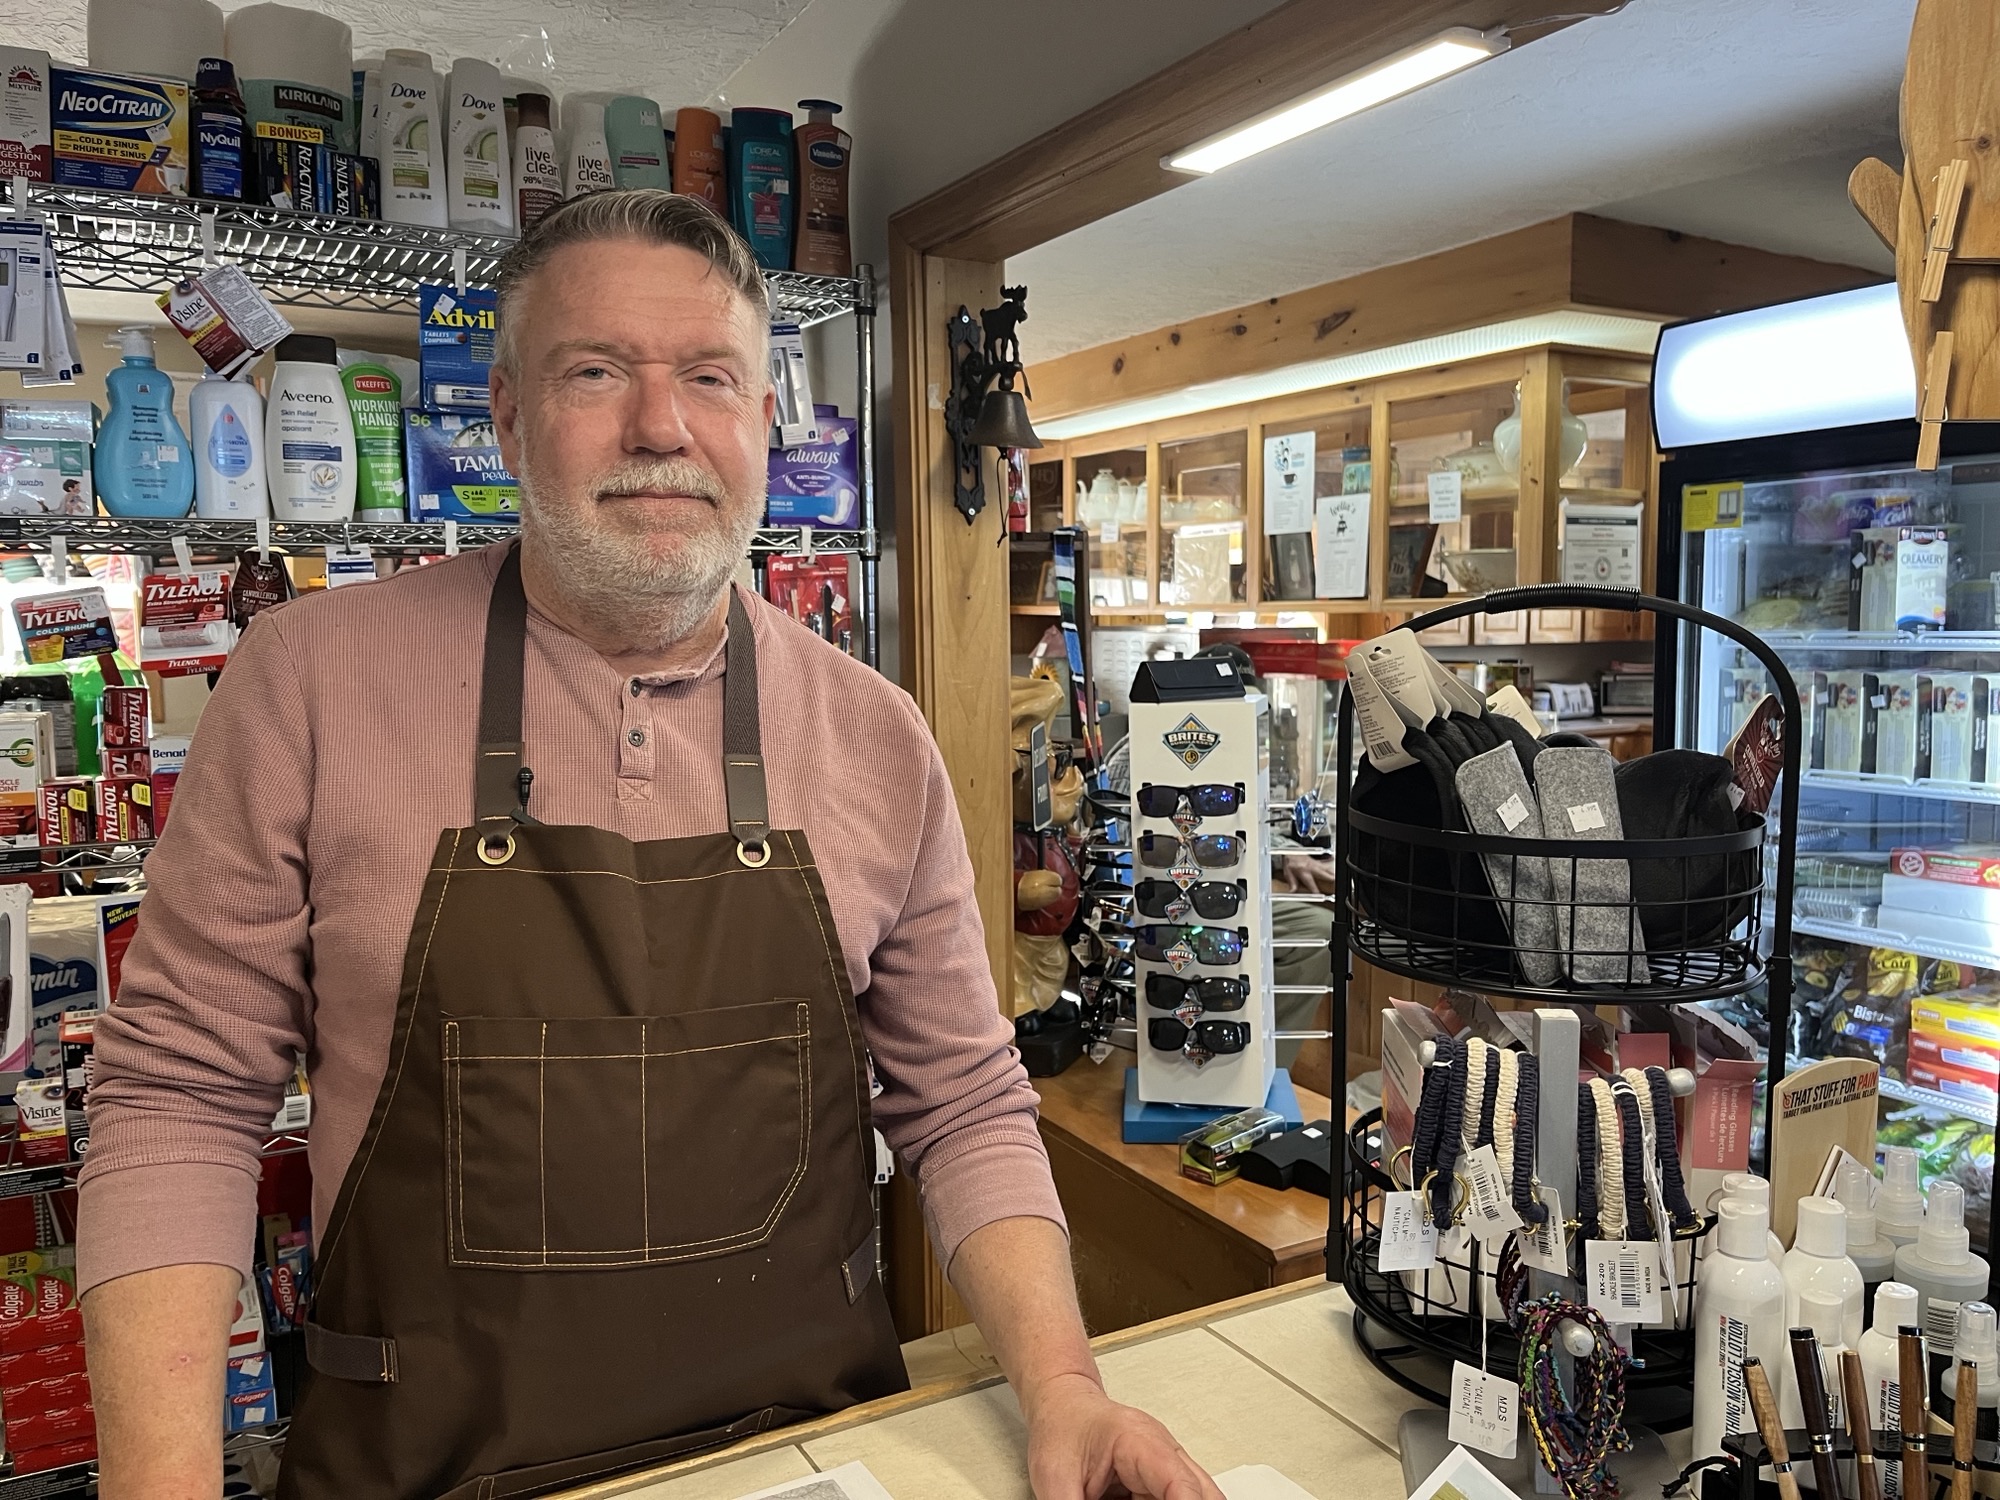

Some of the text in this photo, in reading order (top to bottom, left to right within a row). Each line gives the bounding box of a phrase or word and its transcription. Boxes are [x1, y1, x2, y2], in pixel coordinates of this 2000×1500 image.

[8, 83, 42, 92] MIXTURE
[391, 82, 427, 100] Dove
[278, 88, 341, 112] KIRKLAND
[462, 93, 496, 112] Dove
[200, 131, 240, 149] NyQuil
[269, 126, 309, 140] BONUS
[0, 143, 23, 153] UGH
[78, 135, 103, 145] COLD
[104, 137, 112, 146] &
[113, 140, 140, 150] SINUS
[0, 151, 41, 161] GESTION
[72, 143, 105, 155] RHUME
[107, 147, 119, 156] ET
[120, 150, 147, 160] SINUS
[525, 147, 551, 164] live
[811, 147, 843, 161] Vaseline
[19, 162, 30, 170] ET
[526, 160, 560, 178] clean
[577, 155, 603, 171] live
[298, 144, 313, 213] REACTINE
[336, 153, 350, 216] REACTINE
[523, 176, 542, 185] 98%
[578, 169, 612, 185] clean
[809, 173, 837, 186] Cocoa
[525, 191, 554, 199] COCONUT
[809, 183, 840, 195] Radiant
[171, 297, 206, 324] Visine
[424, 308, 496, 330] Advil
[356, 380, 391, 389] O'KEEFFE'S
[280, 389, 333, 404] Aveeno
[297, 410, 318, 418] Relief
[350, 399, 401, 413] WORKING
[359, 413, 400, 427] HANDS
[410, 414, 431, 427] 96
[449, 454, 504, 473] TAM
[786, 448, 841, 470] always
[462, 490, 470, 500] S
[1901, 553, 1946, 565] CREAMERY
[146, 581, 225, 602] TYLENOL
[36, 621, 96, 636] COLD RHUME
[168, 659, 201, 668] TYLENOL
[186, 664, 218, 675] TYLENOL
[128, 692, 143, 745] TYLENOL
[1168, 731, 1215, 743] BRITES
[152, 749, 187, 759] Benad
[0, 778, 20, 786] SCLE
[46, 790, 62, 845] TYLENOL
[104, 785, 120, 842] TYLENOL
[106, 906, 124, 918] NEW!
[1791, 1071, 1878, 1108] THAT STUFF FOR PAIN
[1783, 1087, 1877, 1119] TARGET YOUR PAIN WITH ALL NATURAL RELIEF
[22, 1105, 62, 1120] Visine
[1728, 1087, 1739, 1153] Reading Glasses
[1717, 1087, 1729, 1164] Lunettes de lecture
[1608, 1259, 1617, 1301] SHACKLE BRACELET
[40, 1280, 63, 1313] Colgate
[277, 1267, 295, 1315] Colgate
[0, 1285, 24, 1320] Colgate
[1726, 1317, 1743, 1403] MUSCLE LOTION
[233, 1391, 268, 1404] Colgate
[1474, 1406, 1483, 1416] ME
[1499, 1395, 1508, 1422] MDS
[1884, 1381, 1900, 1497] SOOTHIN LOTION
